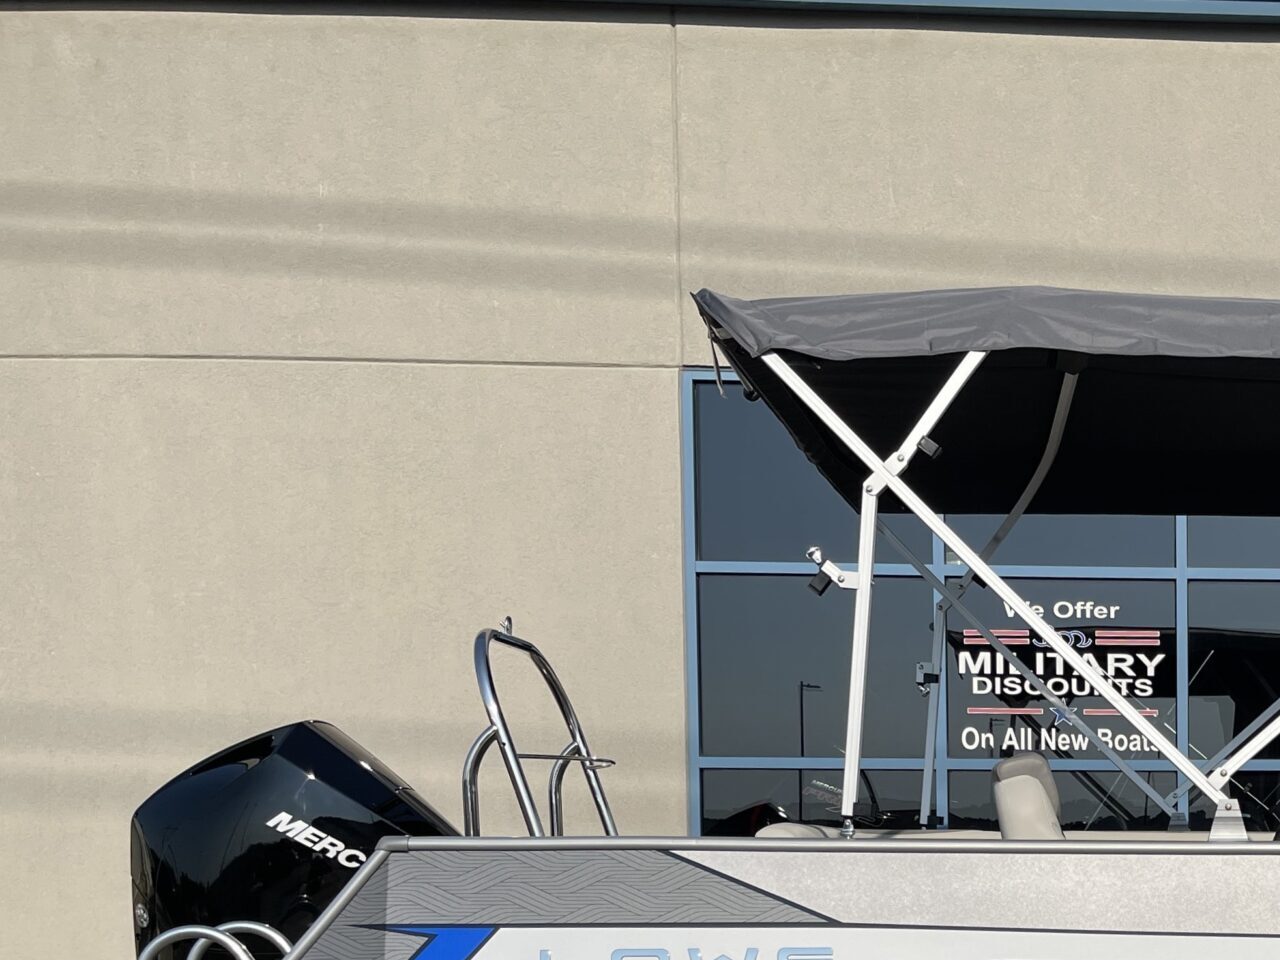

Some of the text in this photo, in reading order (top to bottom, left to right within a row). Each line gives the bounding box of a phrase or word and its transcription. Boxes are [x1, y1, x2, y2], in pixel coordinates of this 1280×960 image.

[1053, 601, 1120, 619] Offer
[961, 727, 995, 750] On
[1002, 727, 1033, 750] All
[1041, 728, 1089, 751] New
[265, 811, 367, 868] MERC
